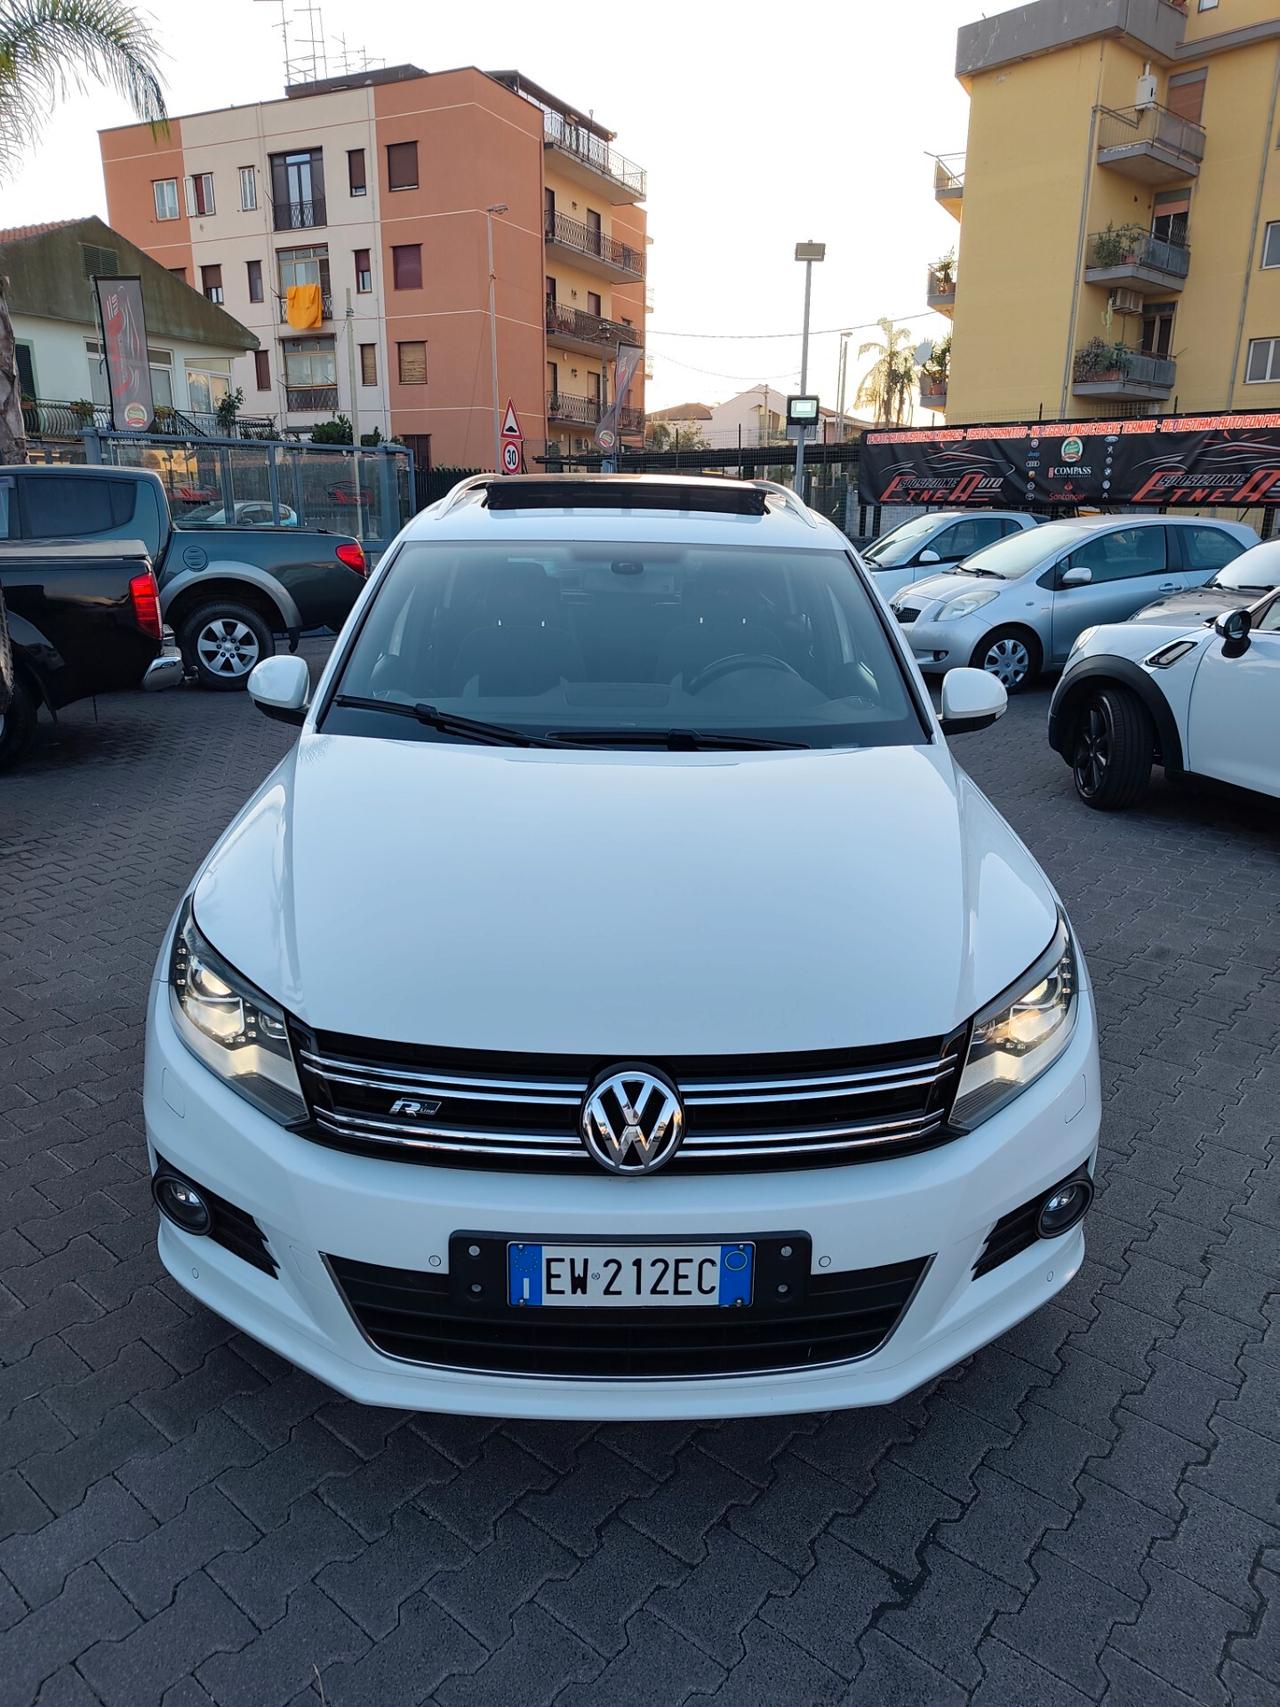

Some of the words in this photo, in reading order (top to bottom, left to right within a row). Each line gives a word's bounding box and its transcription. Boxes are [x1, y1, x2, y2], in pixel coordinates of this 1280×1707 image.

[1121, 420, 1157, 434] TERMINE
[506, 448, 517, 466] 30
[1054, 466, 1092, 476] COMPASS
